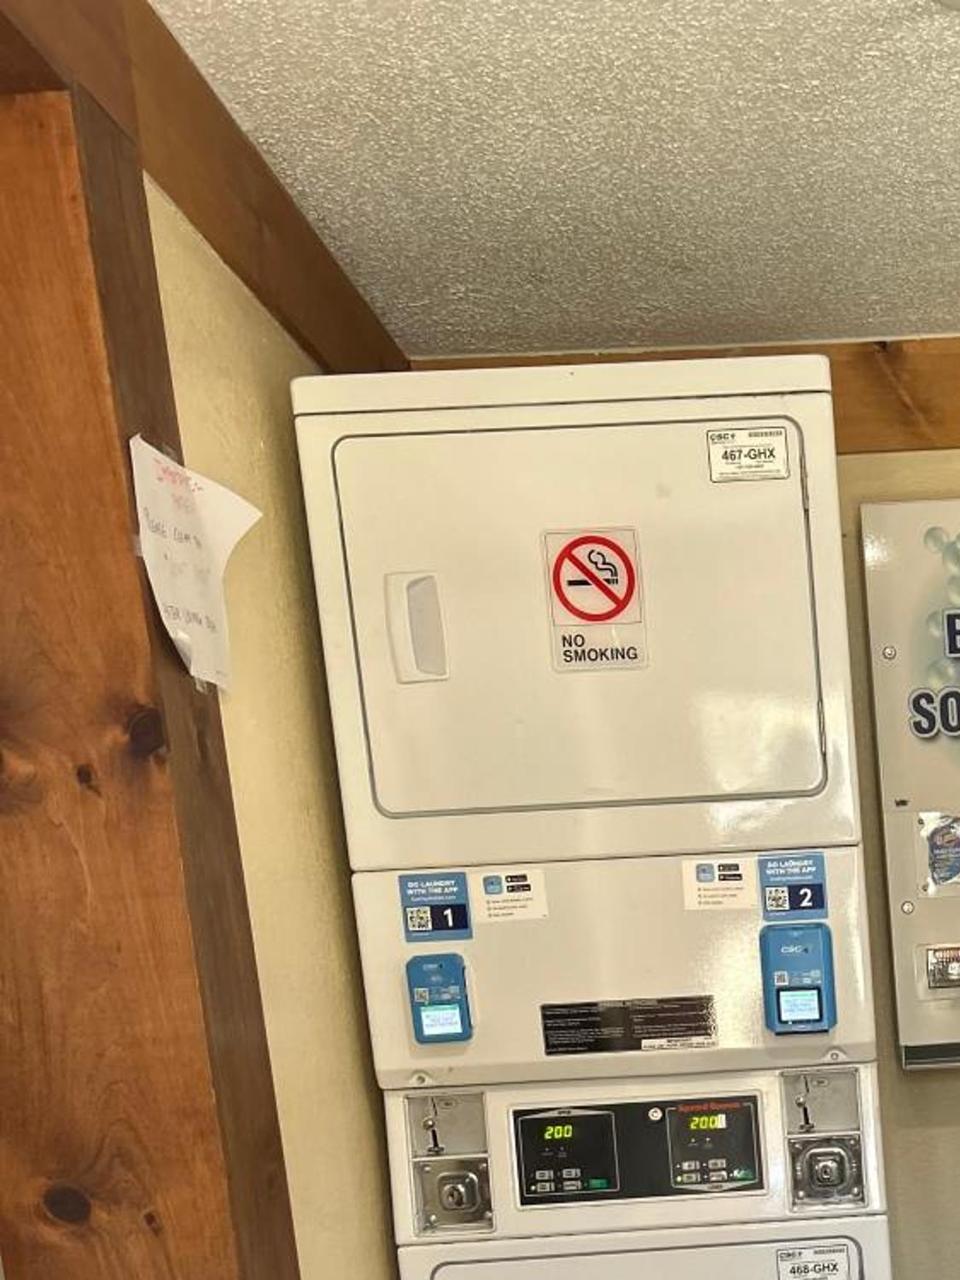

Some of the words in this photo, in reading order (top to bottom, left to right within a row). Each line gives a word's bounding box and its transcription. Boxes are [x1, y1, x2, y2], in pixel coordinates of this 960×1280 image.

[721, 447, 776, 461] 467-GHX
[562, 634, 586, 648] NO
[563, 646, 638, 663] SMOKING
[799, 887, 813, 907] 2
[443, 908, 453, 927] 1
[544, 1124, 573, 1139] 200
